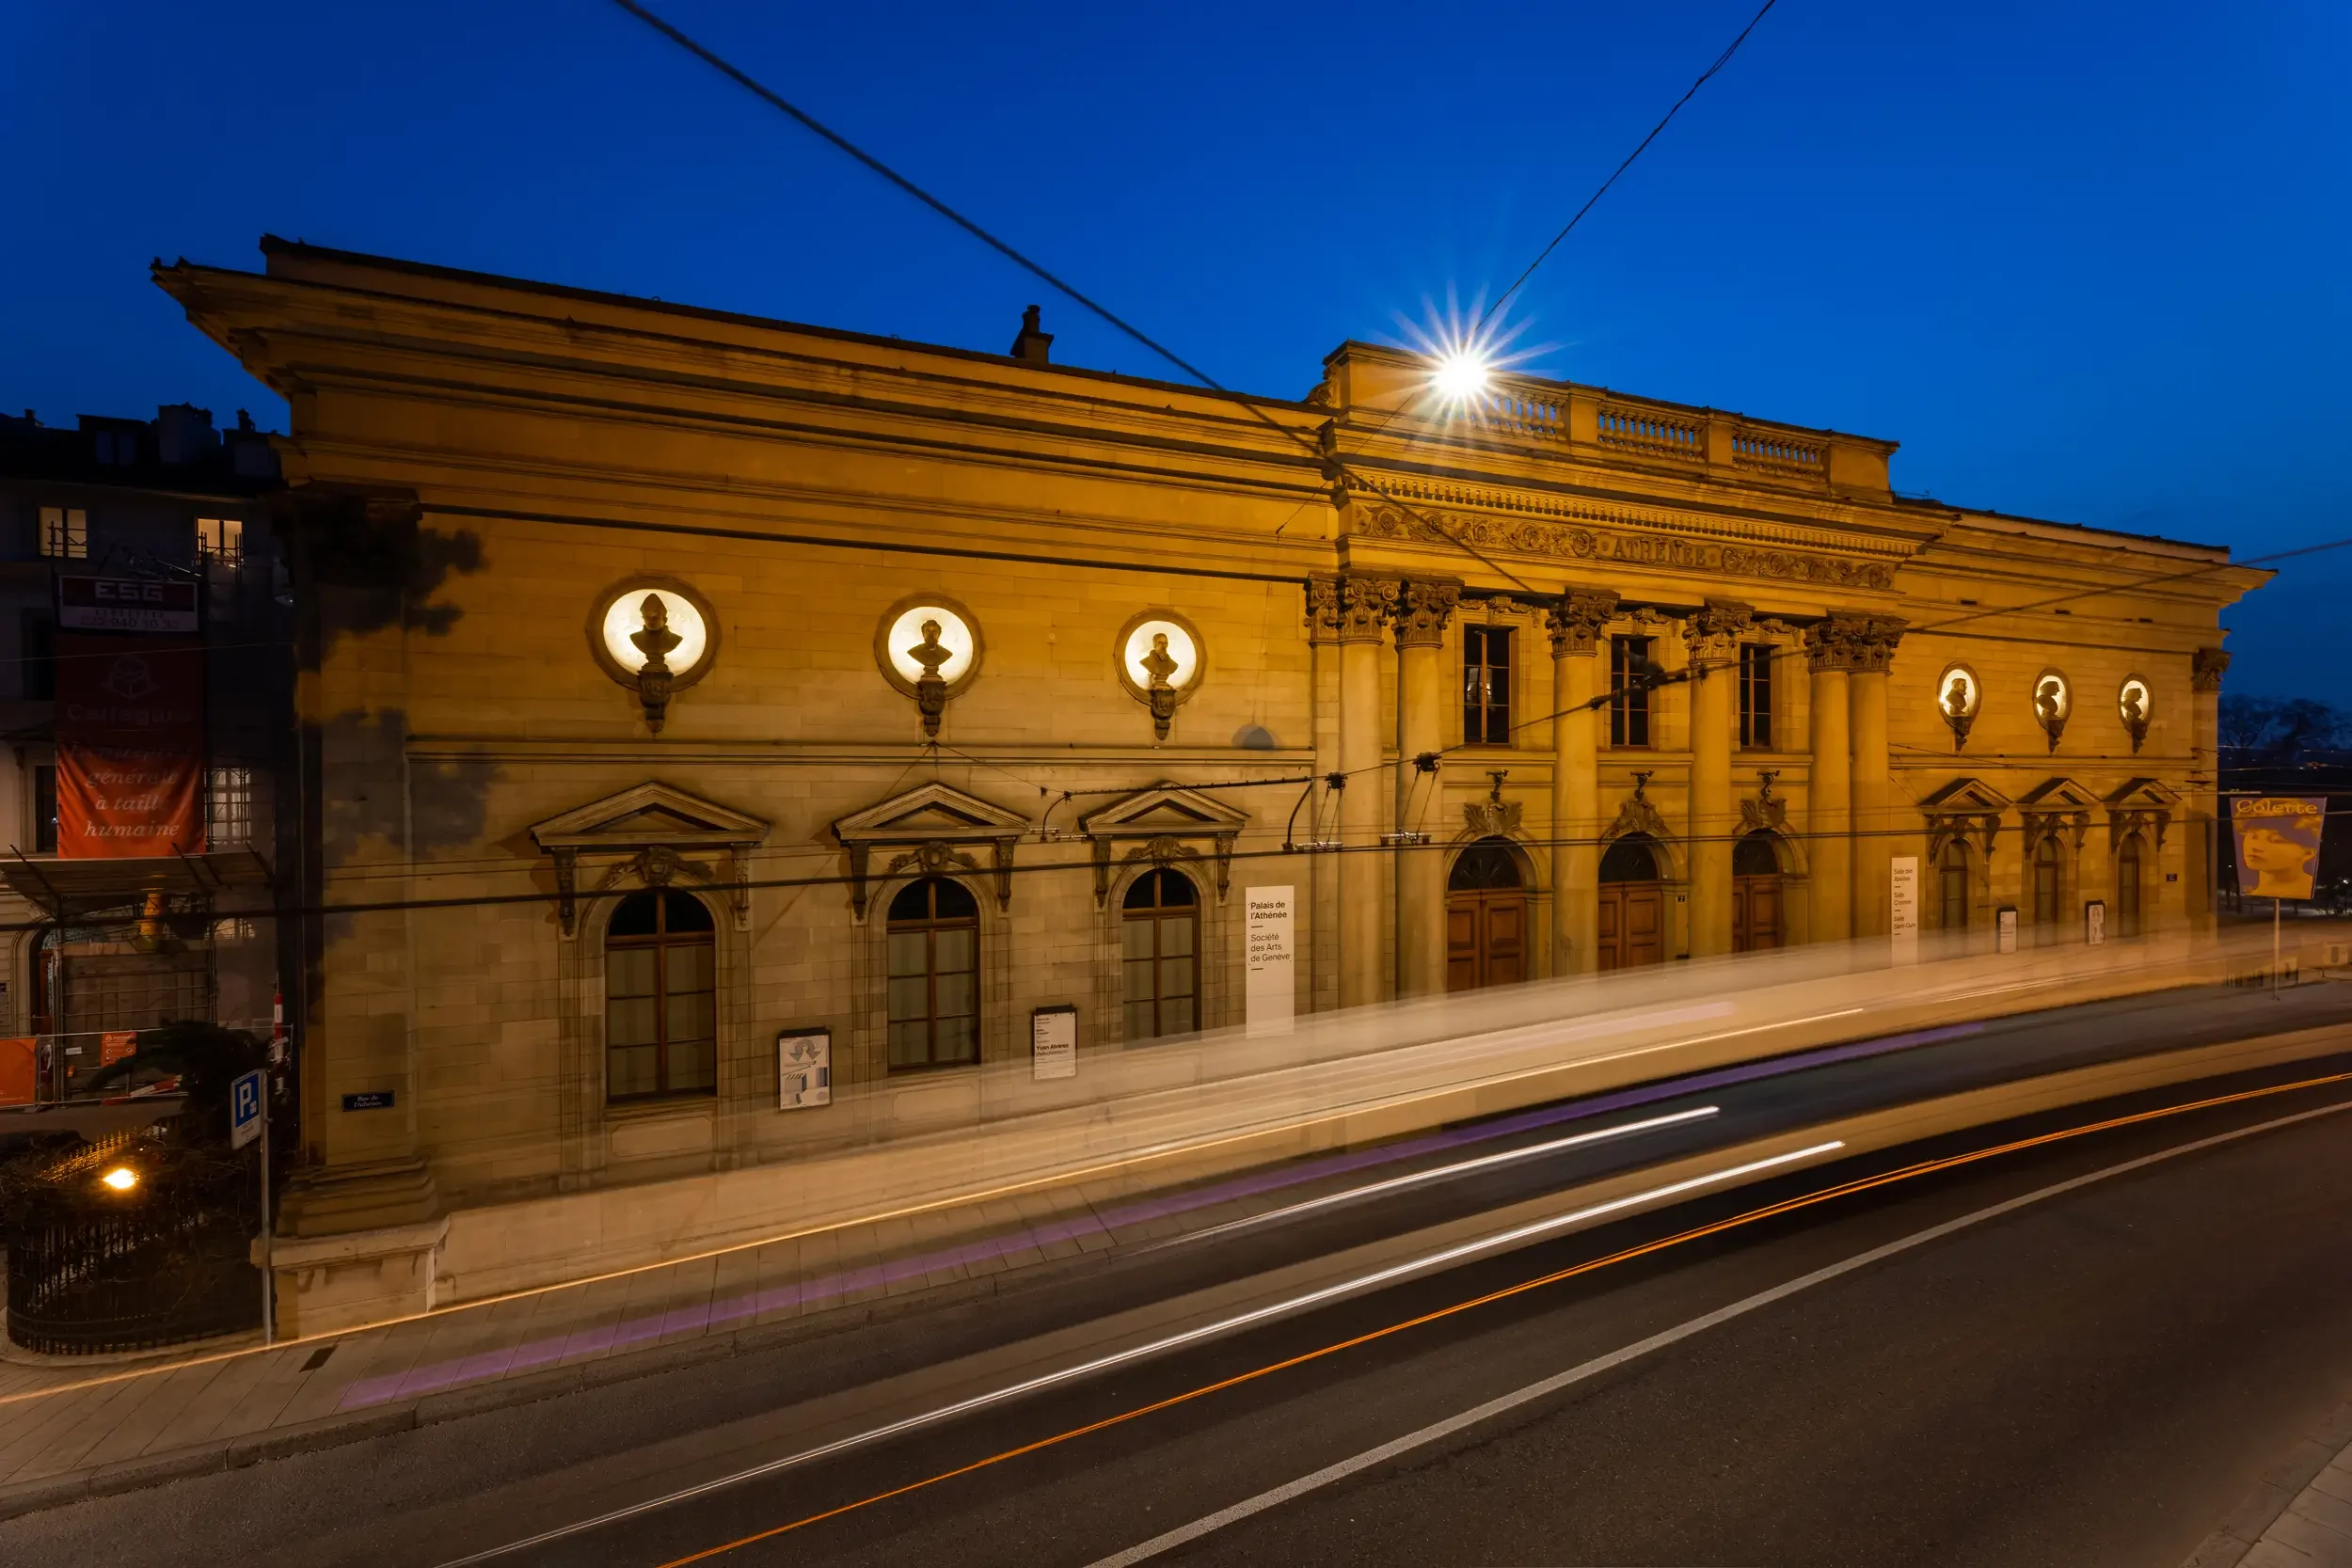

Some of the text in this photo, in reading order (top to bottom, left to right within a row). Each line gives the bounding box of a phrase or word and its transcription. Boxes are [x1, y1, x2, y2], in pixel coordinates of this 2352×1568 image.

[95, 581, 164, 602] ESG
[110, 617, 138, 629] 940
[86, 768, 179, 788] générale
[96, 793, 169, 813] à taille
[2235, 799, 2318, 815] Colette
[85, 820, 180, 837] humaine
[1250, 900, 1286, 910] Palais de
[1250, 911, 1287, 920] l'Athénée
[1250, 932, 1279, 942] Société
[1250, 943, 1265, 952] des
[1250, 952, 1291, 962] de Genève
[239, 1082, 252, 1118] P
